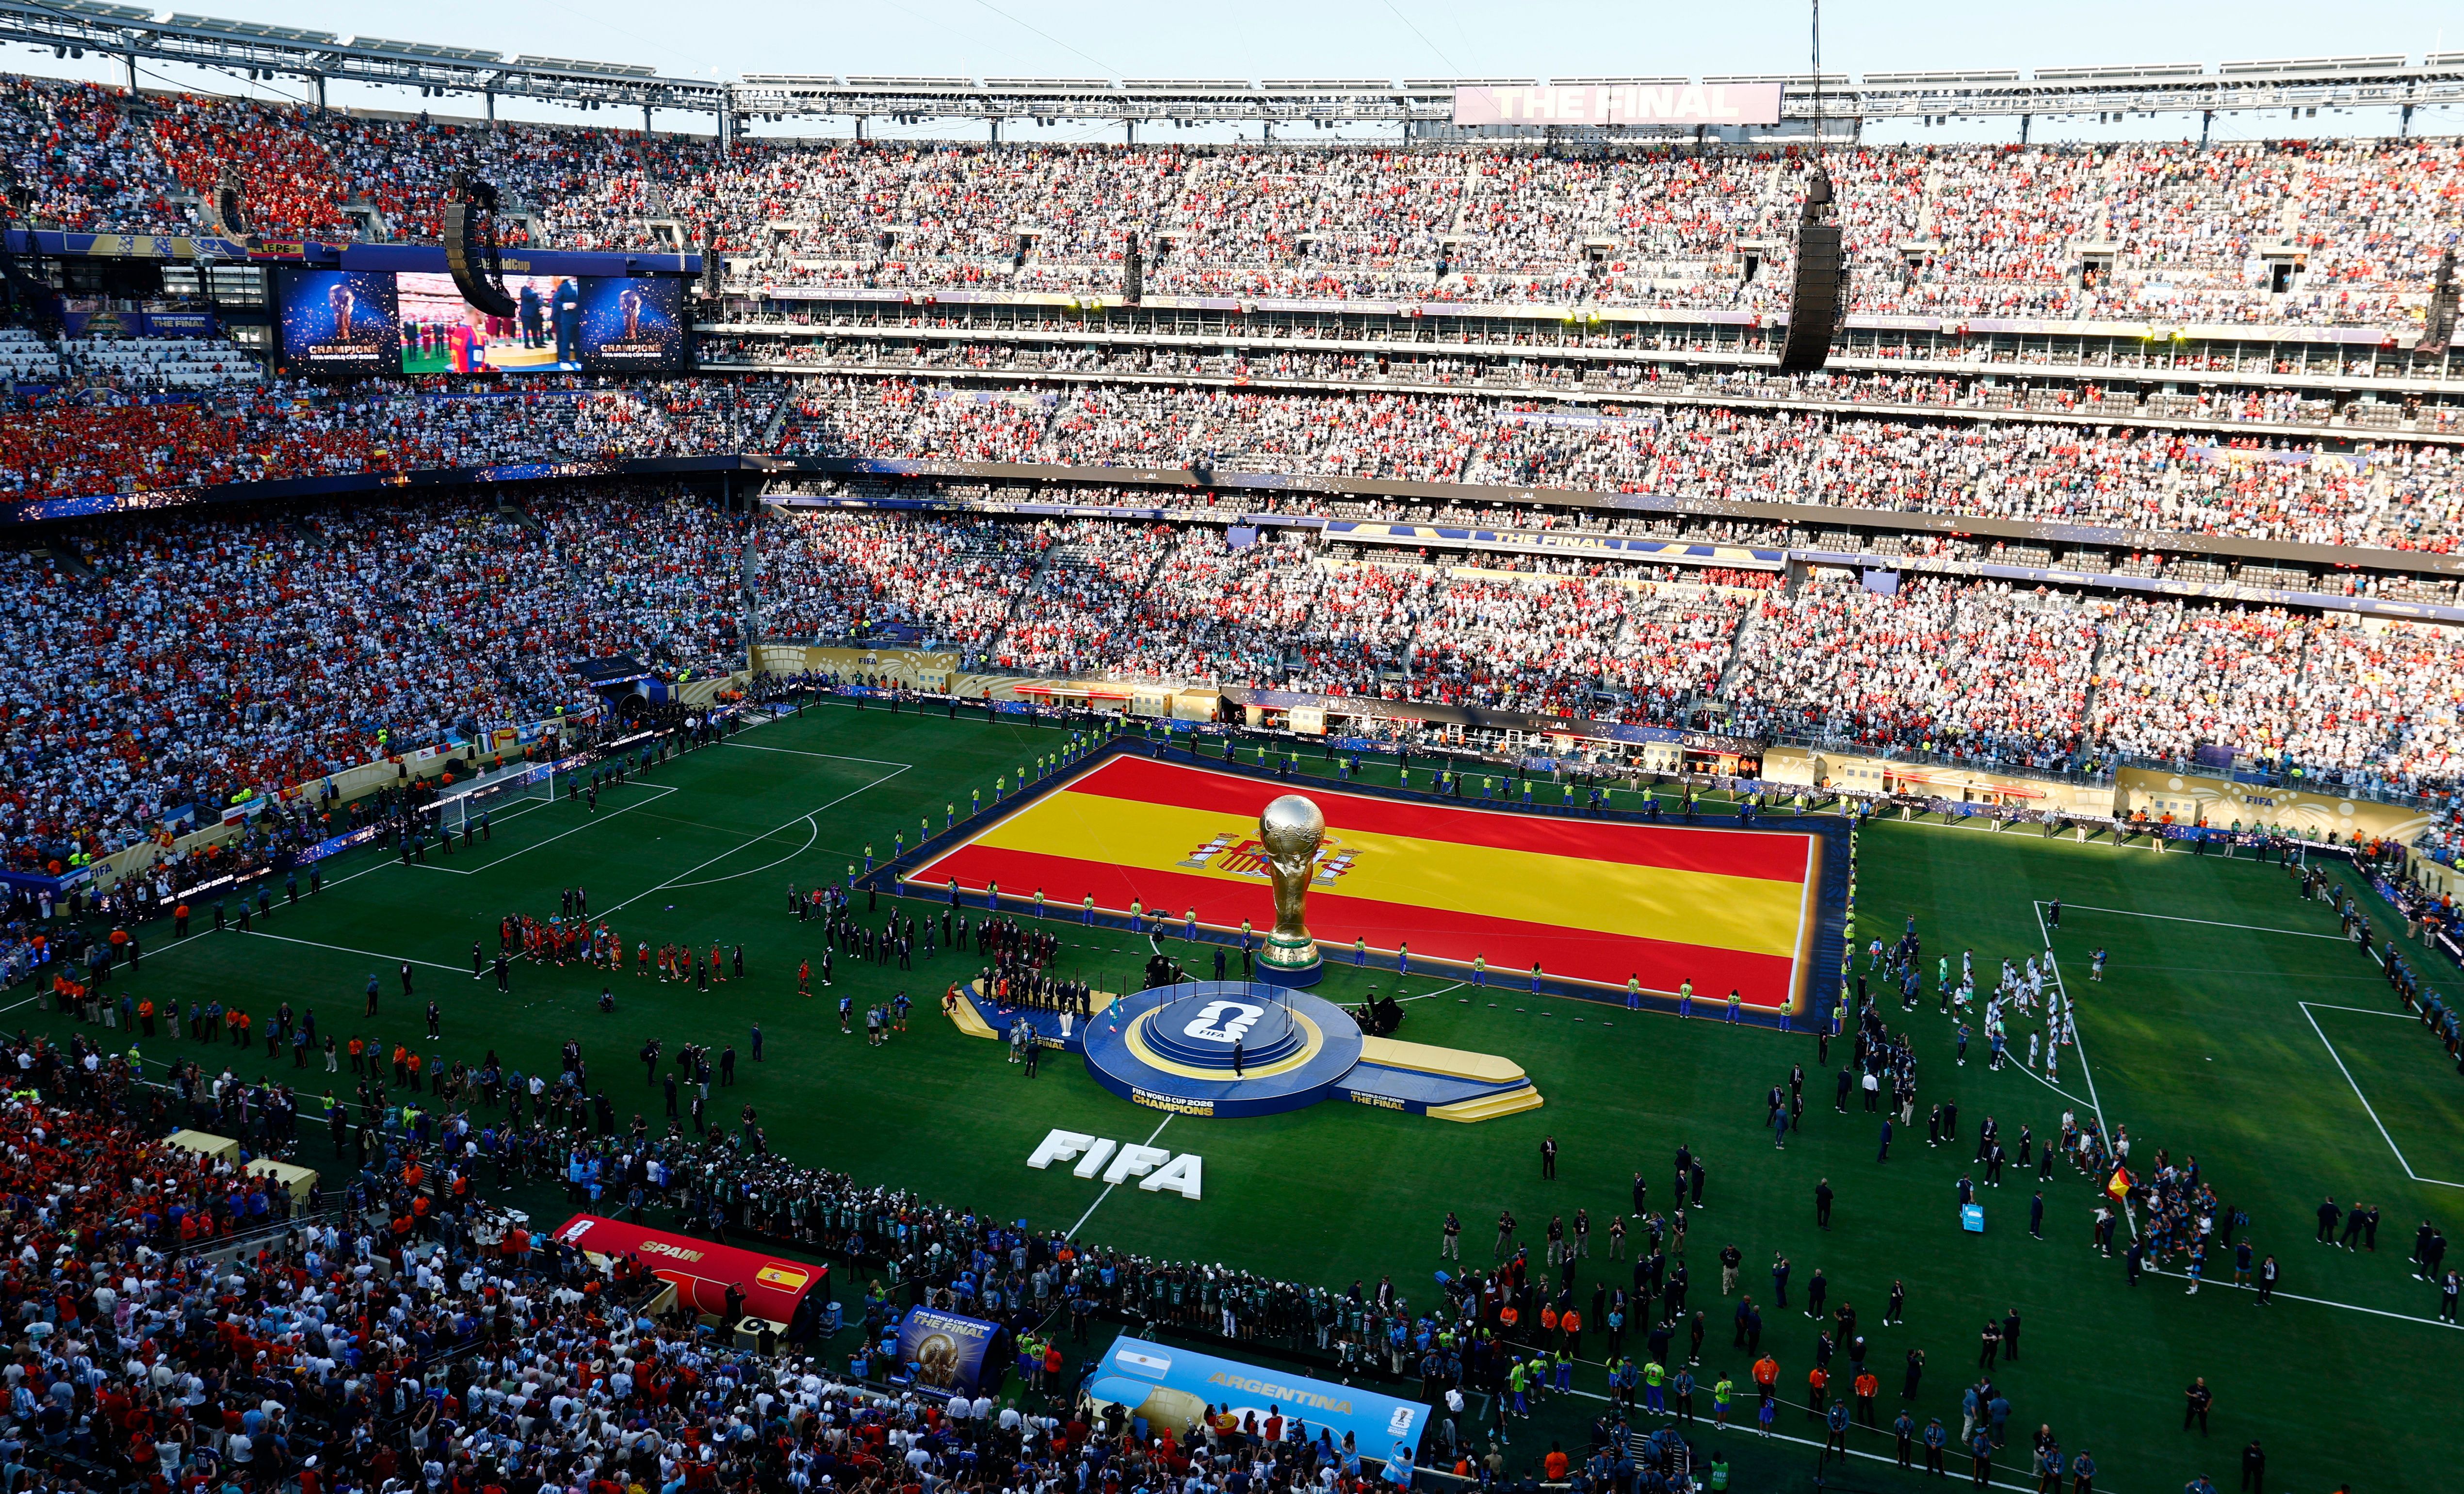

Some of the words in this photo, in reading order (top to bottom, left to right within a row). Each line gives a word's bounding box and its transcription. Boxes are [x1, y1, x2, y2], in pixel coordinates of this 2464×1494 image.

[1492, 87, 1586, 119] THE
[1595, 85, 1739, 119] FINAL
[262, 244, 290, 253] LEPE
[308, 345, 379, 354] CHAMPIONS
[1567, 419, 1598, 427] 2026
[1493, 533, 1539, 545] THE
[1542, 536, 1611, 549] FINAL
[1536, 720, 1570, 731] FINAL
[619, 736, 632, 745] WORLD
[640, 730, 653, 738] 2026
[429, 799, 447, 810] WORLD
[447, 795, 456, 803] CUP
[2246, 795, 2273, 807] FIFA
[2301, 840, 2326, 848] WORLD
[90, 863, 113, 879] FIFA
[161, 896, 175, 906] FIFA
[198, 882, 211, 891] CUP
[211, 875, 234, 887] 2026
[235, 874, 250, 884] THE
[1266, 944, 1296, 955] FIFA
[1199, 1030, 1225, 1038] FIFA
[1037, 1039, 1065, 1050] FINAL
[1132, 1087, 1146, 1097] FIFA
[1146, 1091, 1171, 1103] WORLD
[1171, 1097, 1186, 1105] CUP
[1187, 1099, 1214, 1108] 2026
[1132, 1094, 1214, 1116] CHAMPIONS
[1350, 1094, 1372, 1105] THE
[1373, 1099, 1405, 1111] FINAL
[1027, 1129, 1201, 1201] FIFA
[639, 1240, 705, 1263] SPAIN
[913, 1315, 942, 1330] THE
[941, 1323, 986, 1339] FINAL
[930, 1314, 954, 1323] WORLD
[968, 1322, 991, 1331] 2026
[1207, 1372, 1352, 1414] ARGENTINA
[948, 1446, 959, 1455] 48
[197, 1457, 208, 1468] 10
